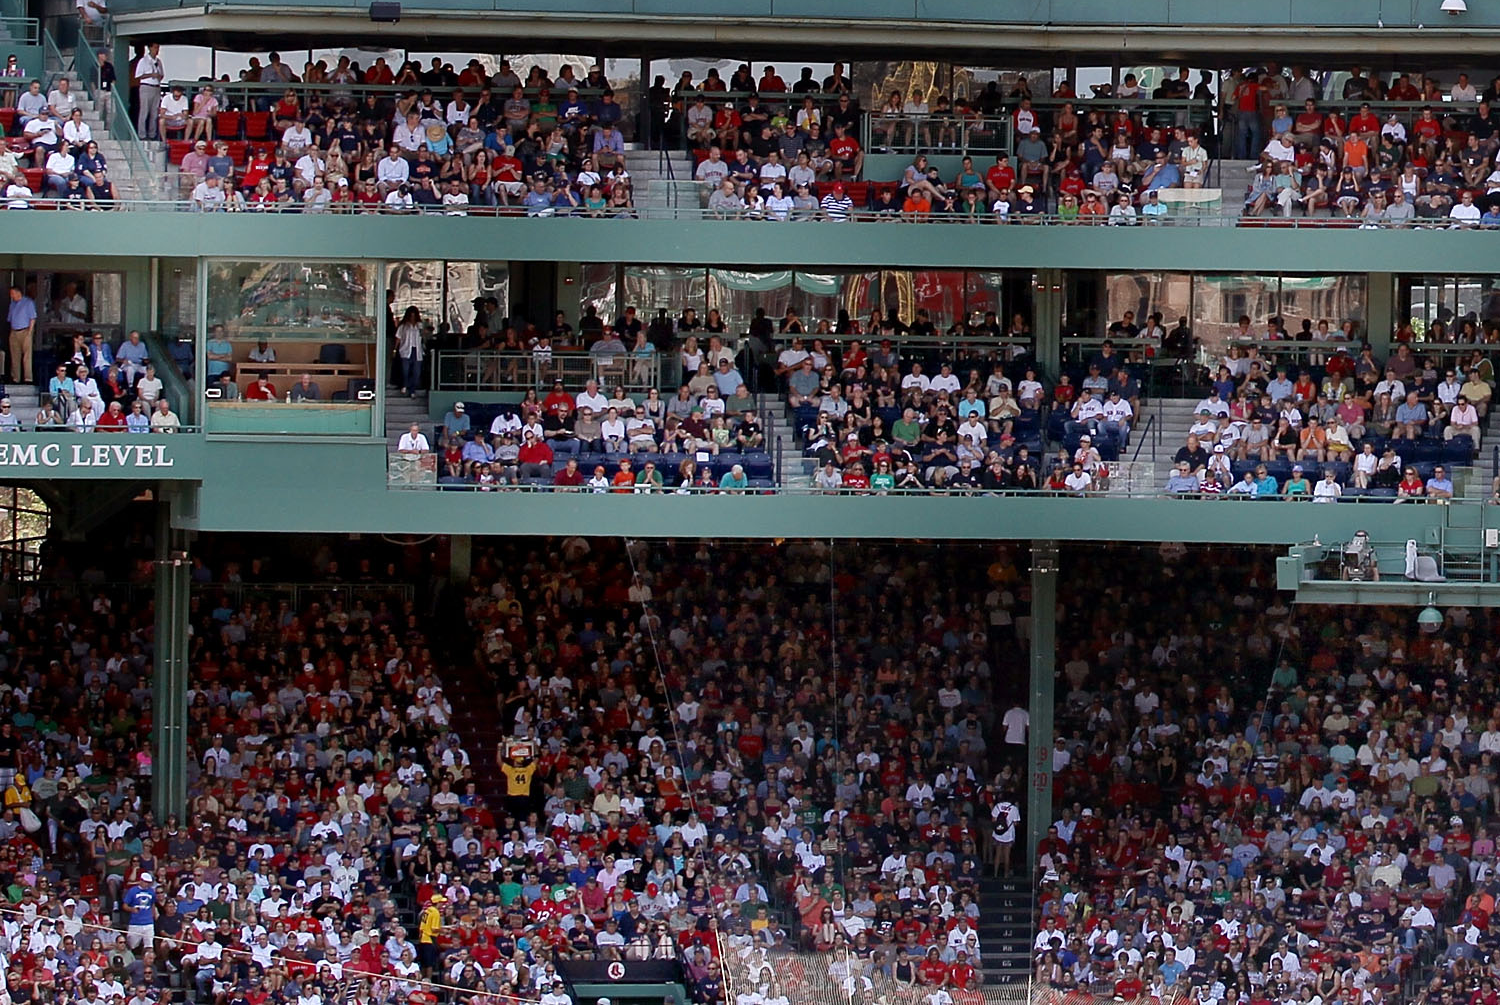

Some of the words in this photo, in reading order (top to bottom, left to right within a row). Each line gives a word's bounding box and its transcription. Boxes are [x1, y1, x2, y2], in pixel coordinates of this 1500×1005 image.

[0, 444, 60, 466] EMC
[71, 444, 174, 466] LEVEL
[515, 774, 526, 784] 44
[1033, 772, 1047, 787] 20
